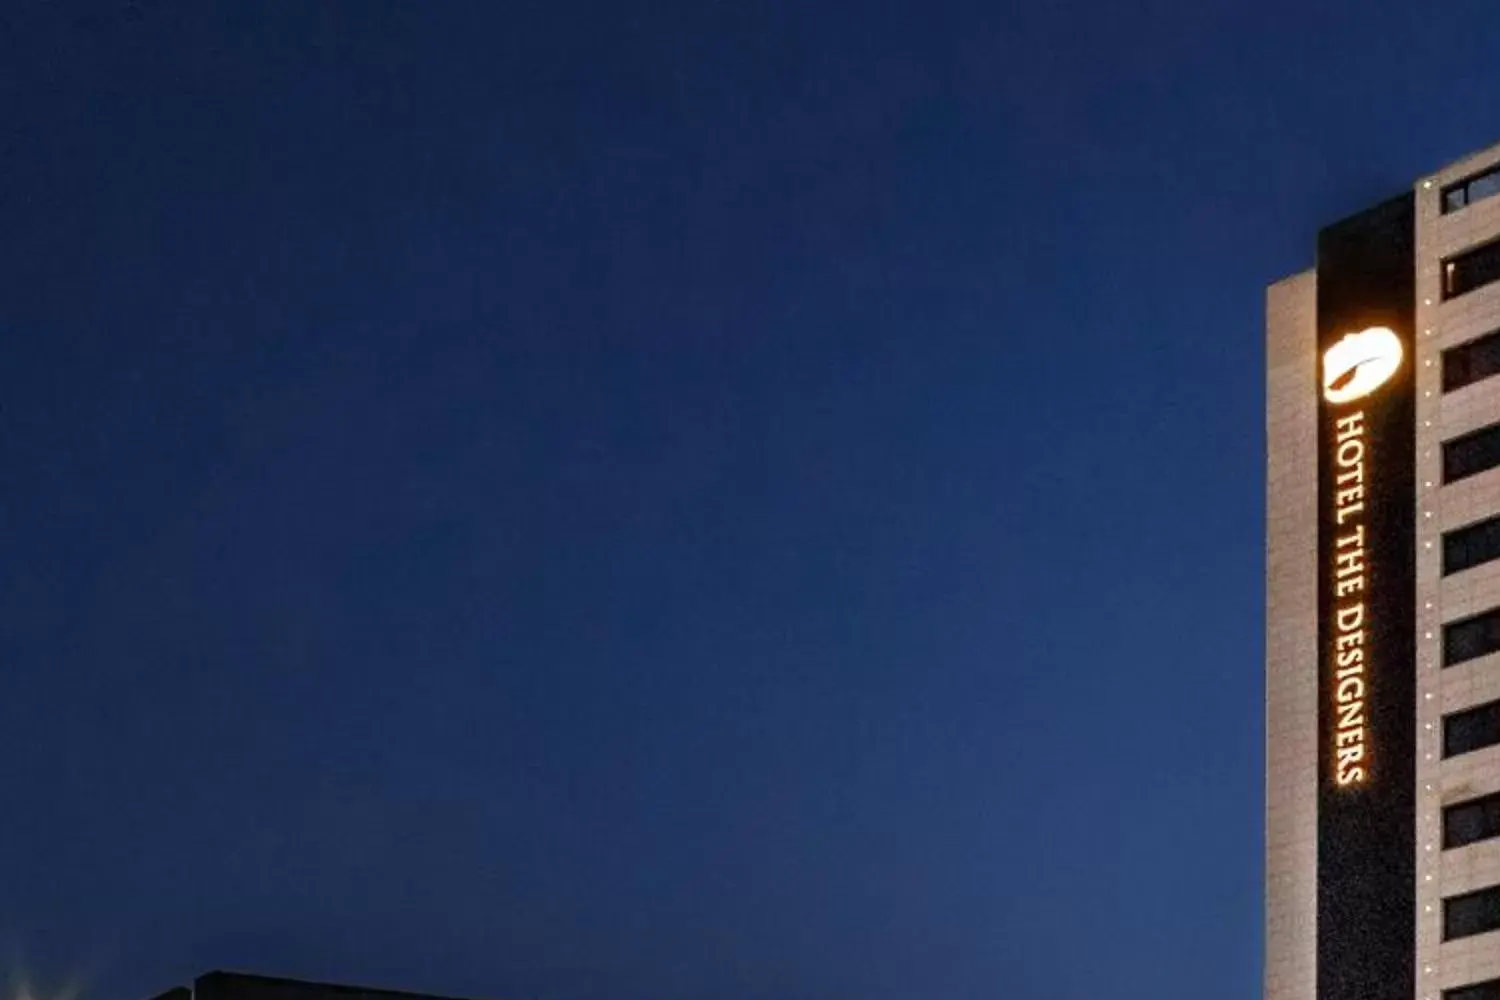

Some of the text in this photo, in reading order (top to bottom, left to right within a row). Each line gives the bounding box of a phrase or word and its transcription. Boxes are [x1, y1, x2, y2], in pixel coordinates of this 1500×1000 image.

[1336, 410, 1365, 787] HOTEL THE DESIGNERS
